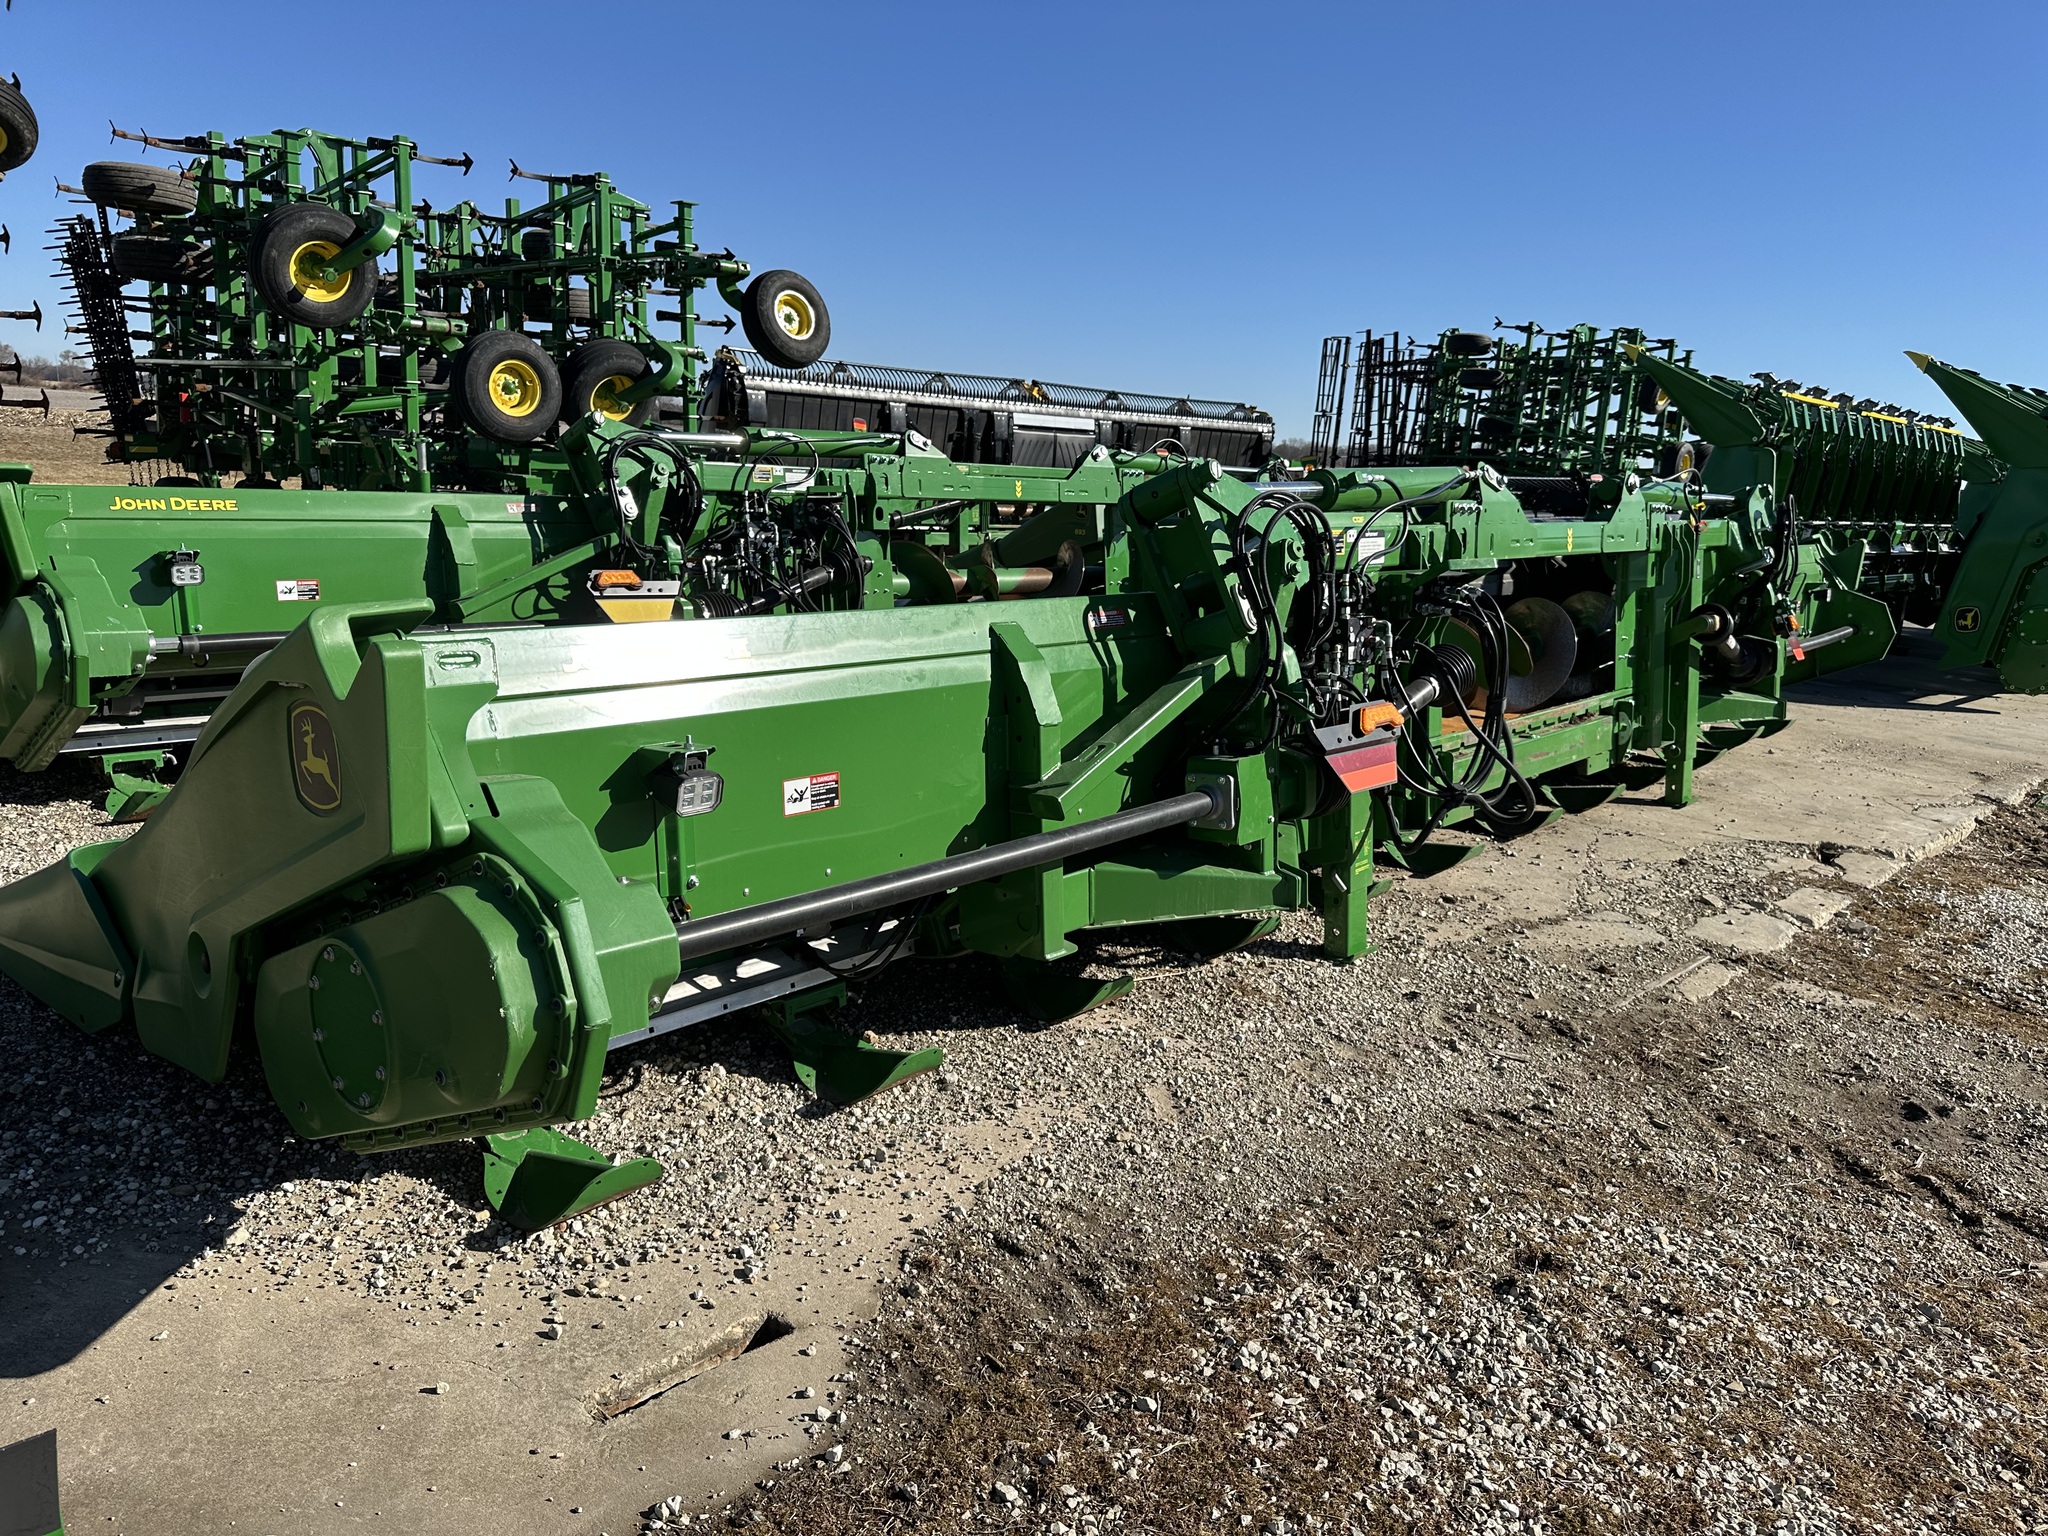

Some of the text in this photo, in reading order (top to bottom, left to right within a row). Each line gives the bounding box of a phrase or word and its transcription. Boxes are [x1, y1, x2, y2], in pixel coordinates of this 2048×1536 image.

[109, 496, 239, 511] JOHN DEERE
[817, 773, 837, 783] DANGER
